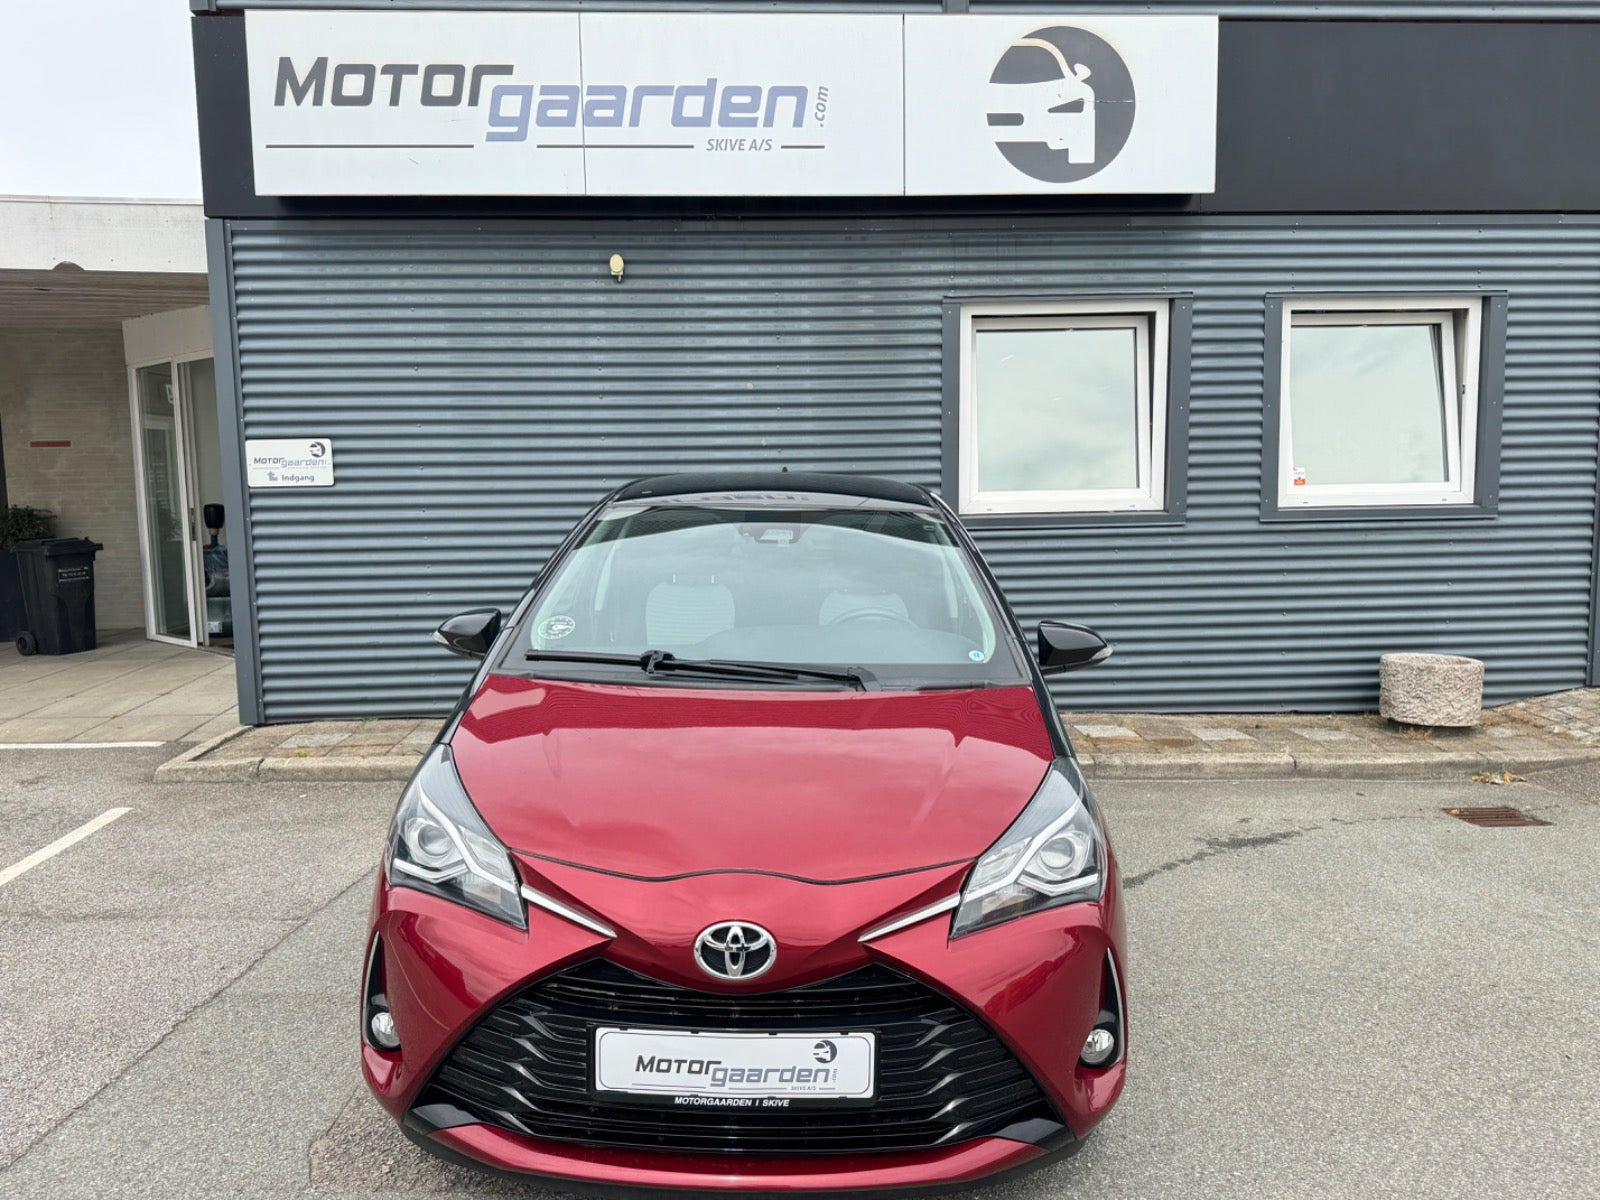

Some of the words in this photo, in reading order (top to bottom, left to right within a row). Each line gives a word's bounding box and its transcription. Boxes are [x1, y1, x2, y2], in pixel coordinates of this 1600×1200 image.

[815, 86, 829, 128] .com
[706, 138, 746, 151] SKIVE
[748, 138, 773, 151] A/S
[281, 474, 315, 483] Indgang
[674, 1096, 752, 1107] MOTORGAARDEN
[762, 1099, 789, 1107] SKIVE
